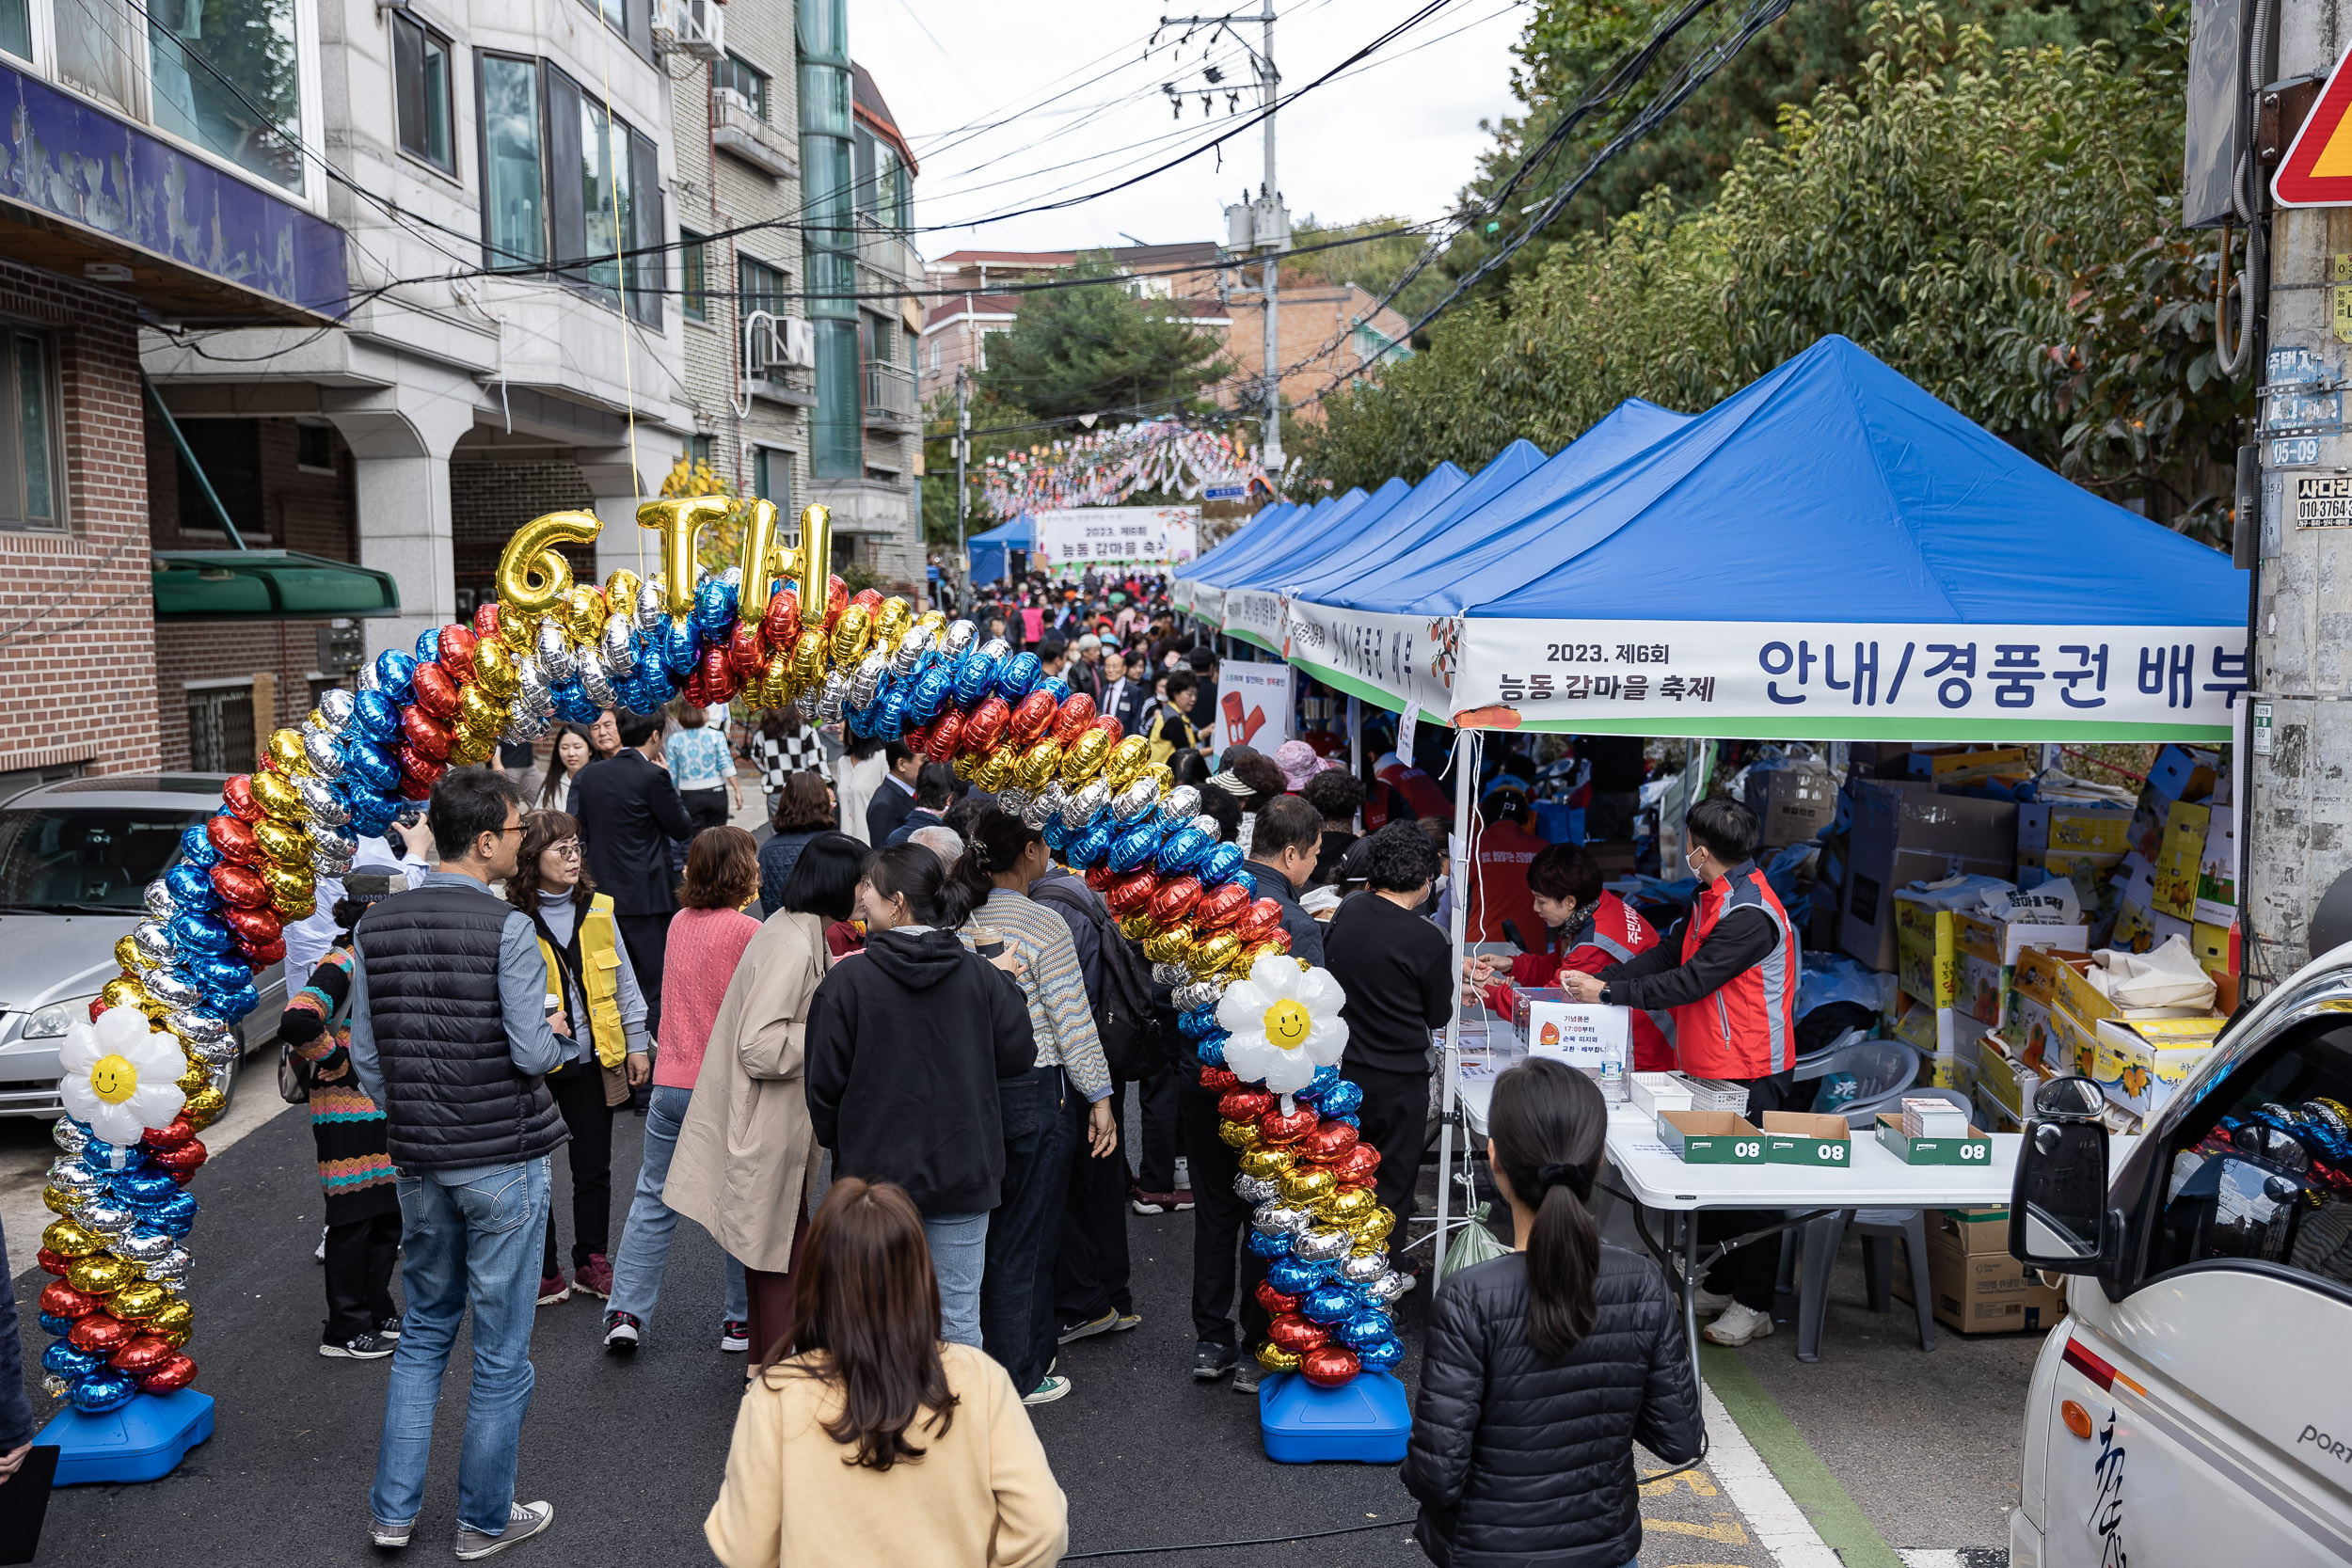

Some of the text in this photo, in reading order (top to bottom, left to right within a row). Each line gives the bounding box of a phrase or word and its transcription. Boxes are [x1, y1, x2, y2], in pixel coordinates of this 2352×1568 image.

[2274, 440, 2316, 464] 05-09
[2299, 479, 2352, 499] 사다리
[1063, 543, 1089, 558] 능동
[1096, 542, 1136, 557] 감마을
[1547, 643, 1670, 665] 2023. 제6회
[1758, 641, 2248, 710] 안내/경품권 배부
[1499, 673, 1716, 703] 능동 감마을 축제
[1564, 1015, 1590, 1023] 기념품은
[1564, 1025, 1595, 1034] 17:00부터
[1735, 1142, 1760, 1158] 08
[1818, 1144, 1844, 1161] 08
[1960, 1144, 1985, 1160] 08
